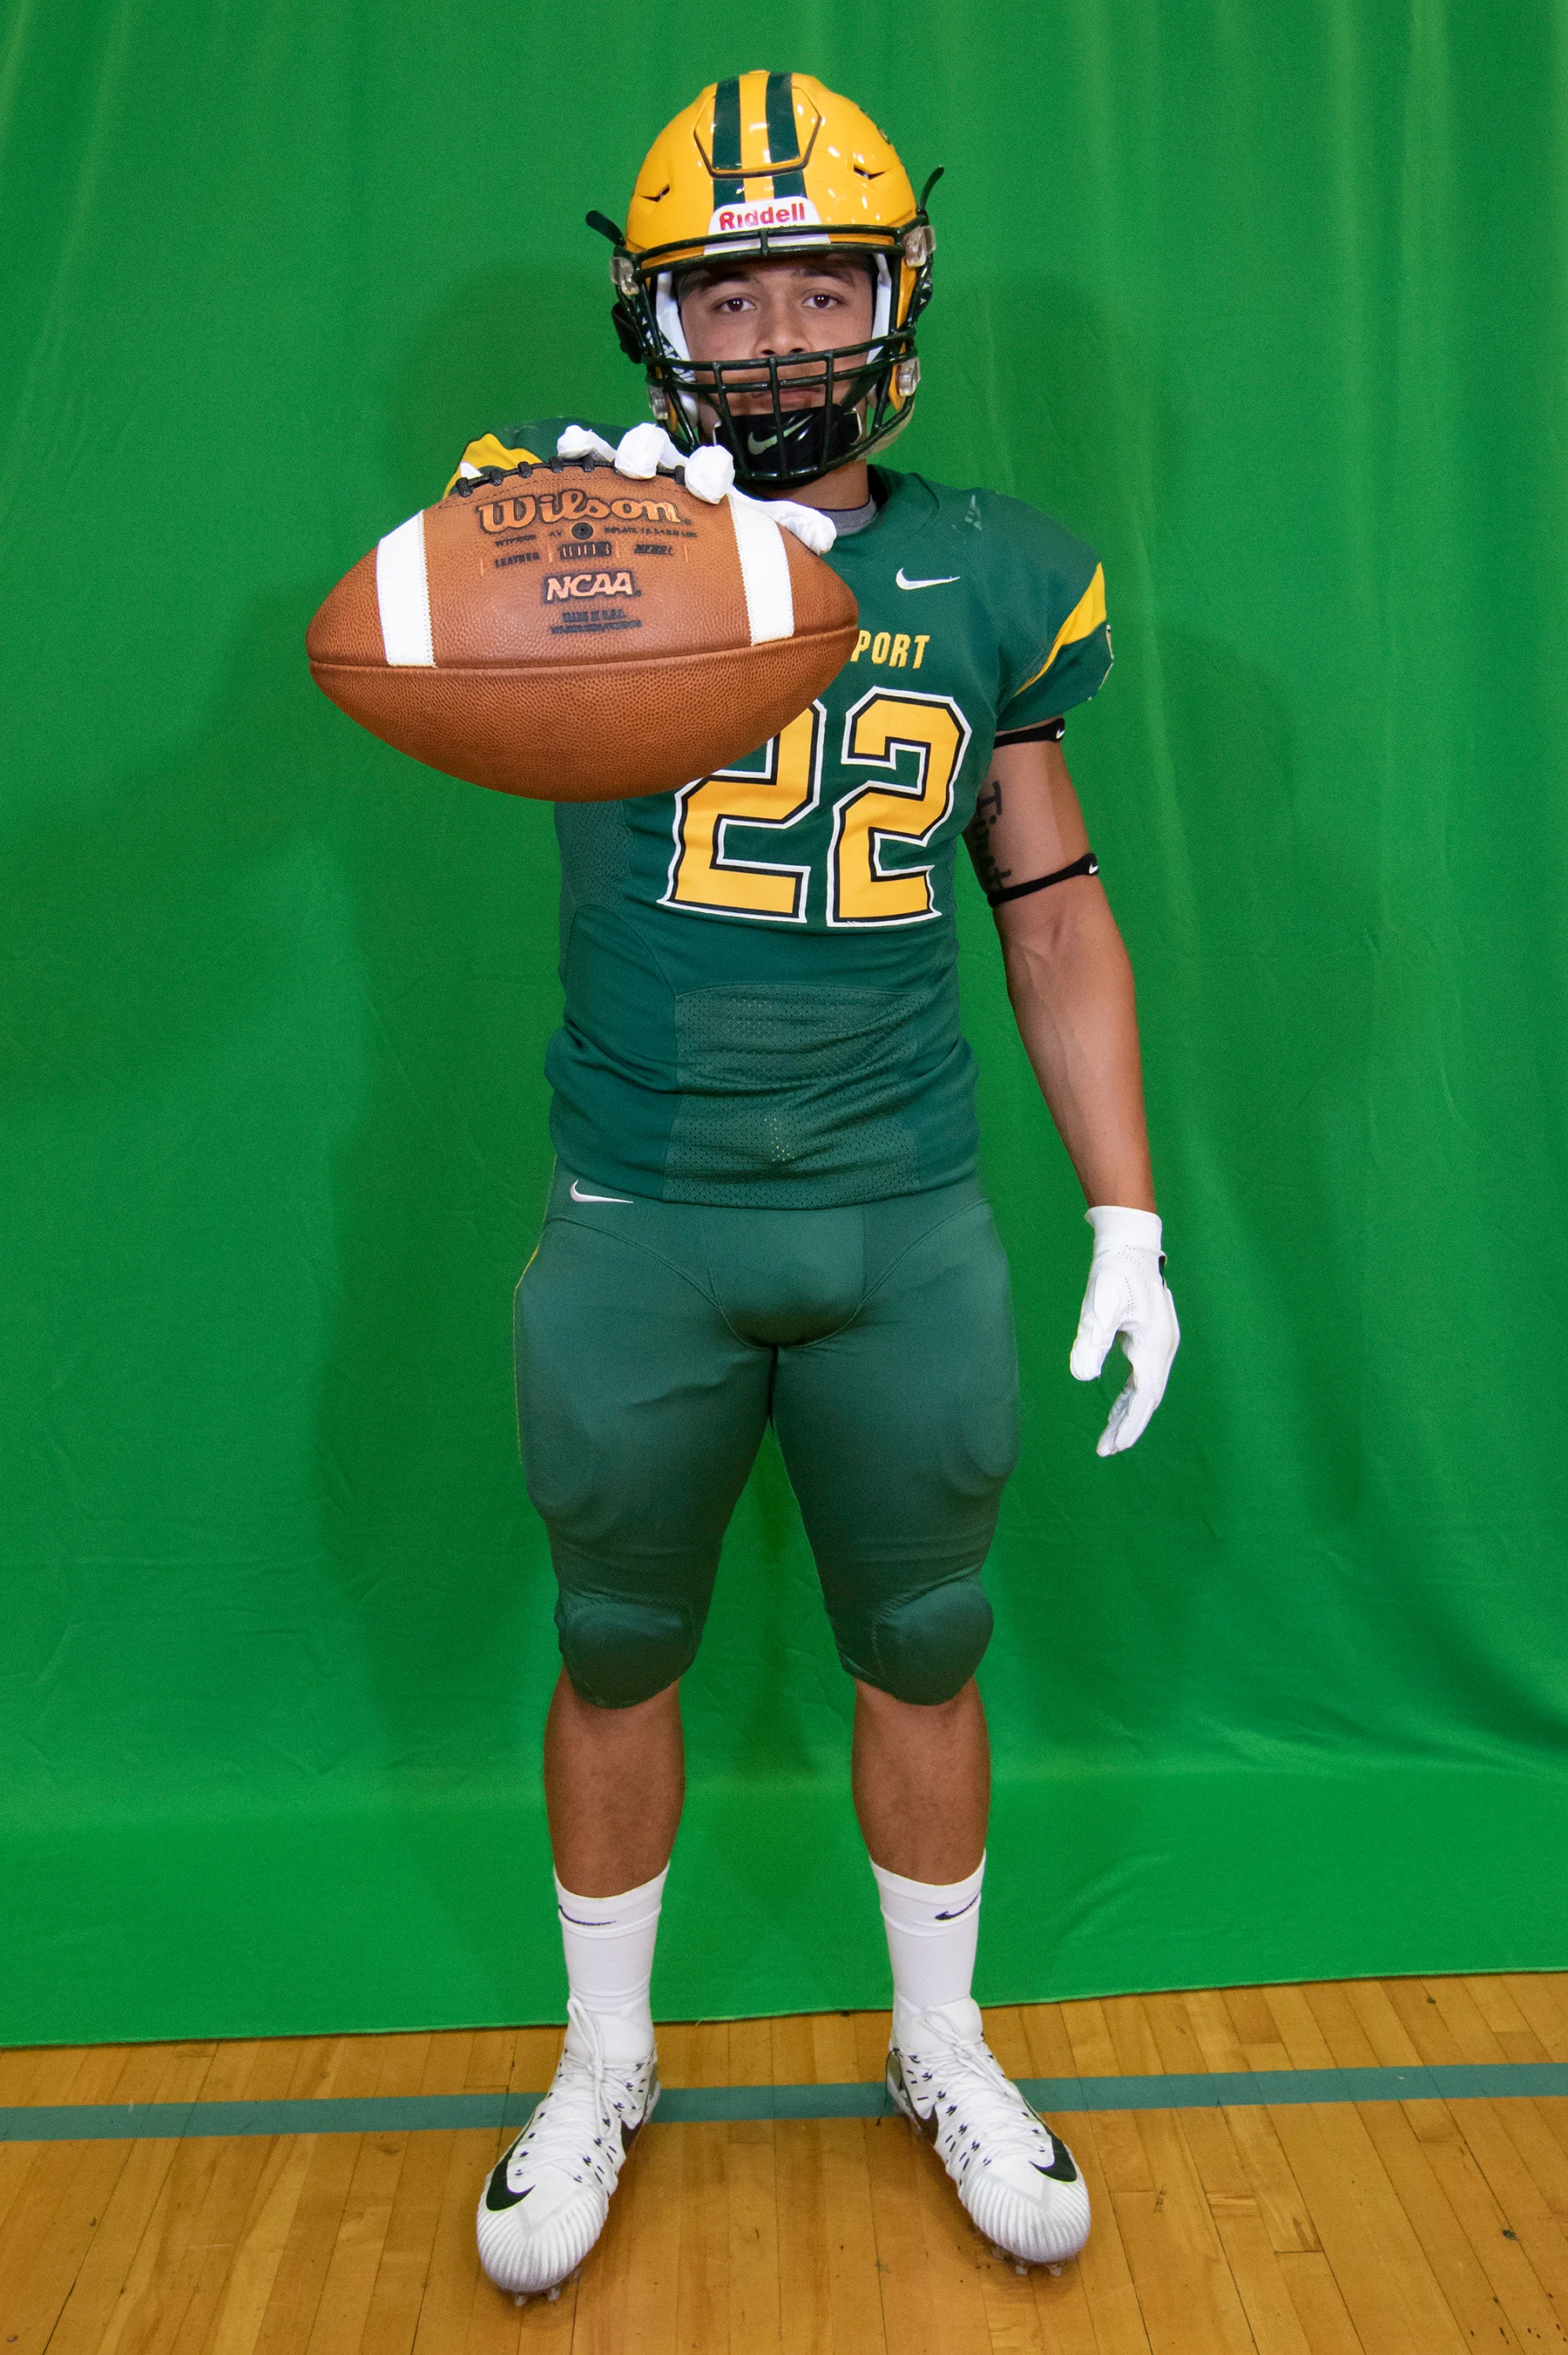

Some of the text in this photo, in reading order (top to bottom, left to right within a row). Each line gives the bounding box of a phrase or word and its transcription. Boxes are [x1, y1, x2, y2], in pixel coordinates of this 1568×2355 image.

[718, 202, 807, 232] Riddell
[476, 488, 684, 535] Wilson
[544, 571, 634, 604] NCAA
[849, 629, 931, 669] PORT
[657, 685, 973, 928] 22
